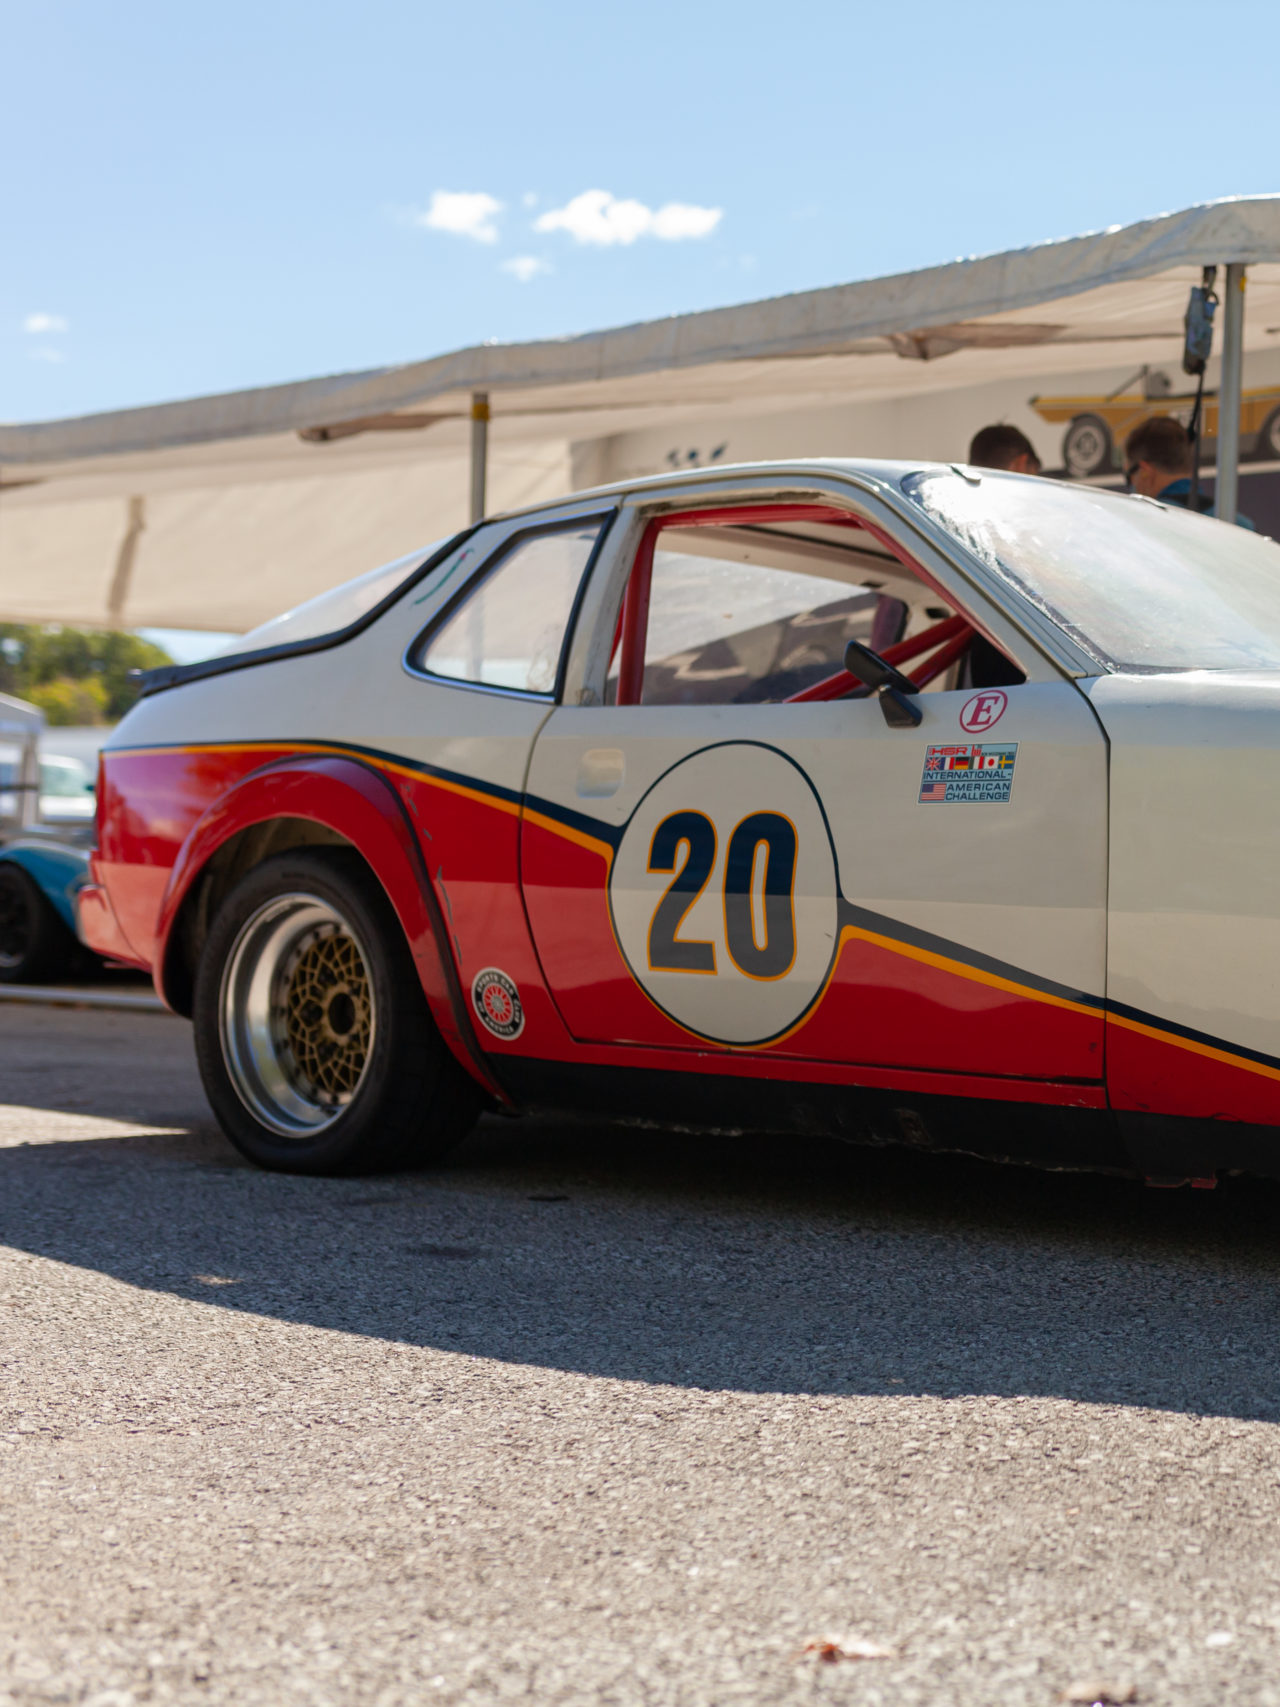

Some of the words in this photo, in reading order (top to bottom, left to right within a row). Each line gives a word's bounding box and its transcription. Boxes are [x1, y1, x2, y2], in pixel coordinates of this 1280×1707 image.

[966, 696, 1001, 726] E
[945, 792, 1009, 801] CHALLENGE
[946, 783, 1011, 792] AMERICAN
[646, 808, 799, 982] 20
